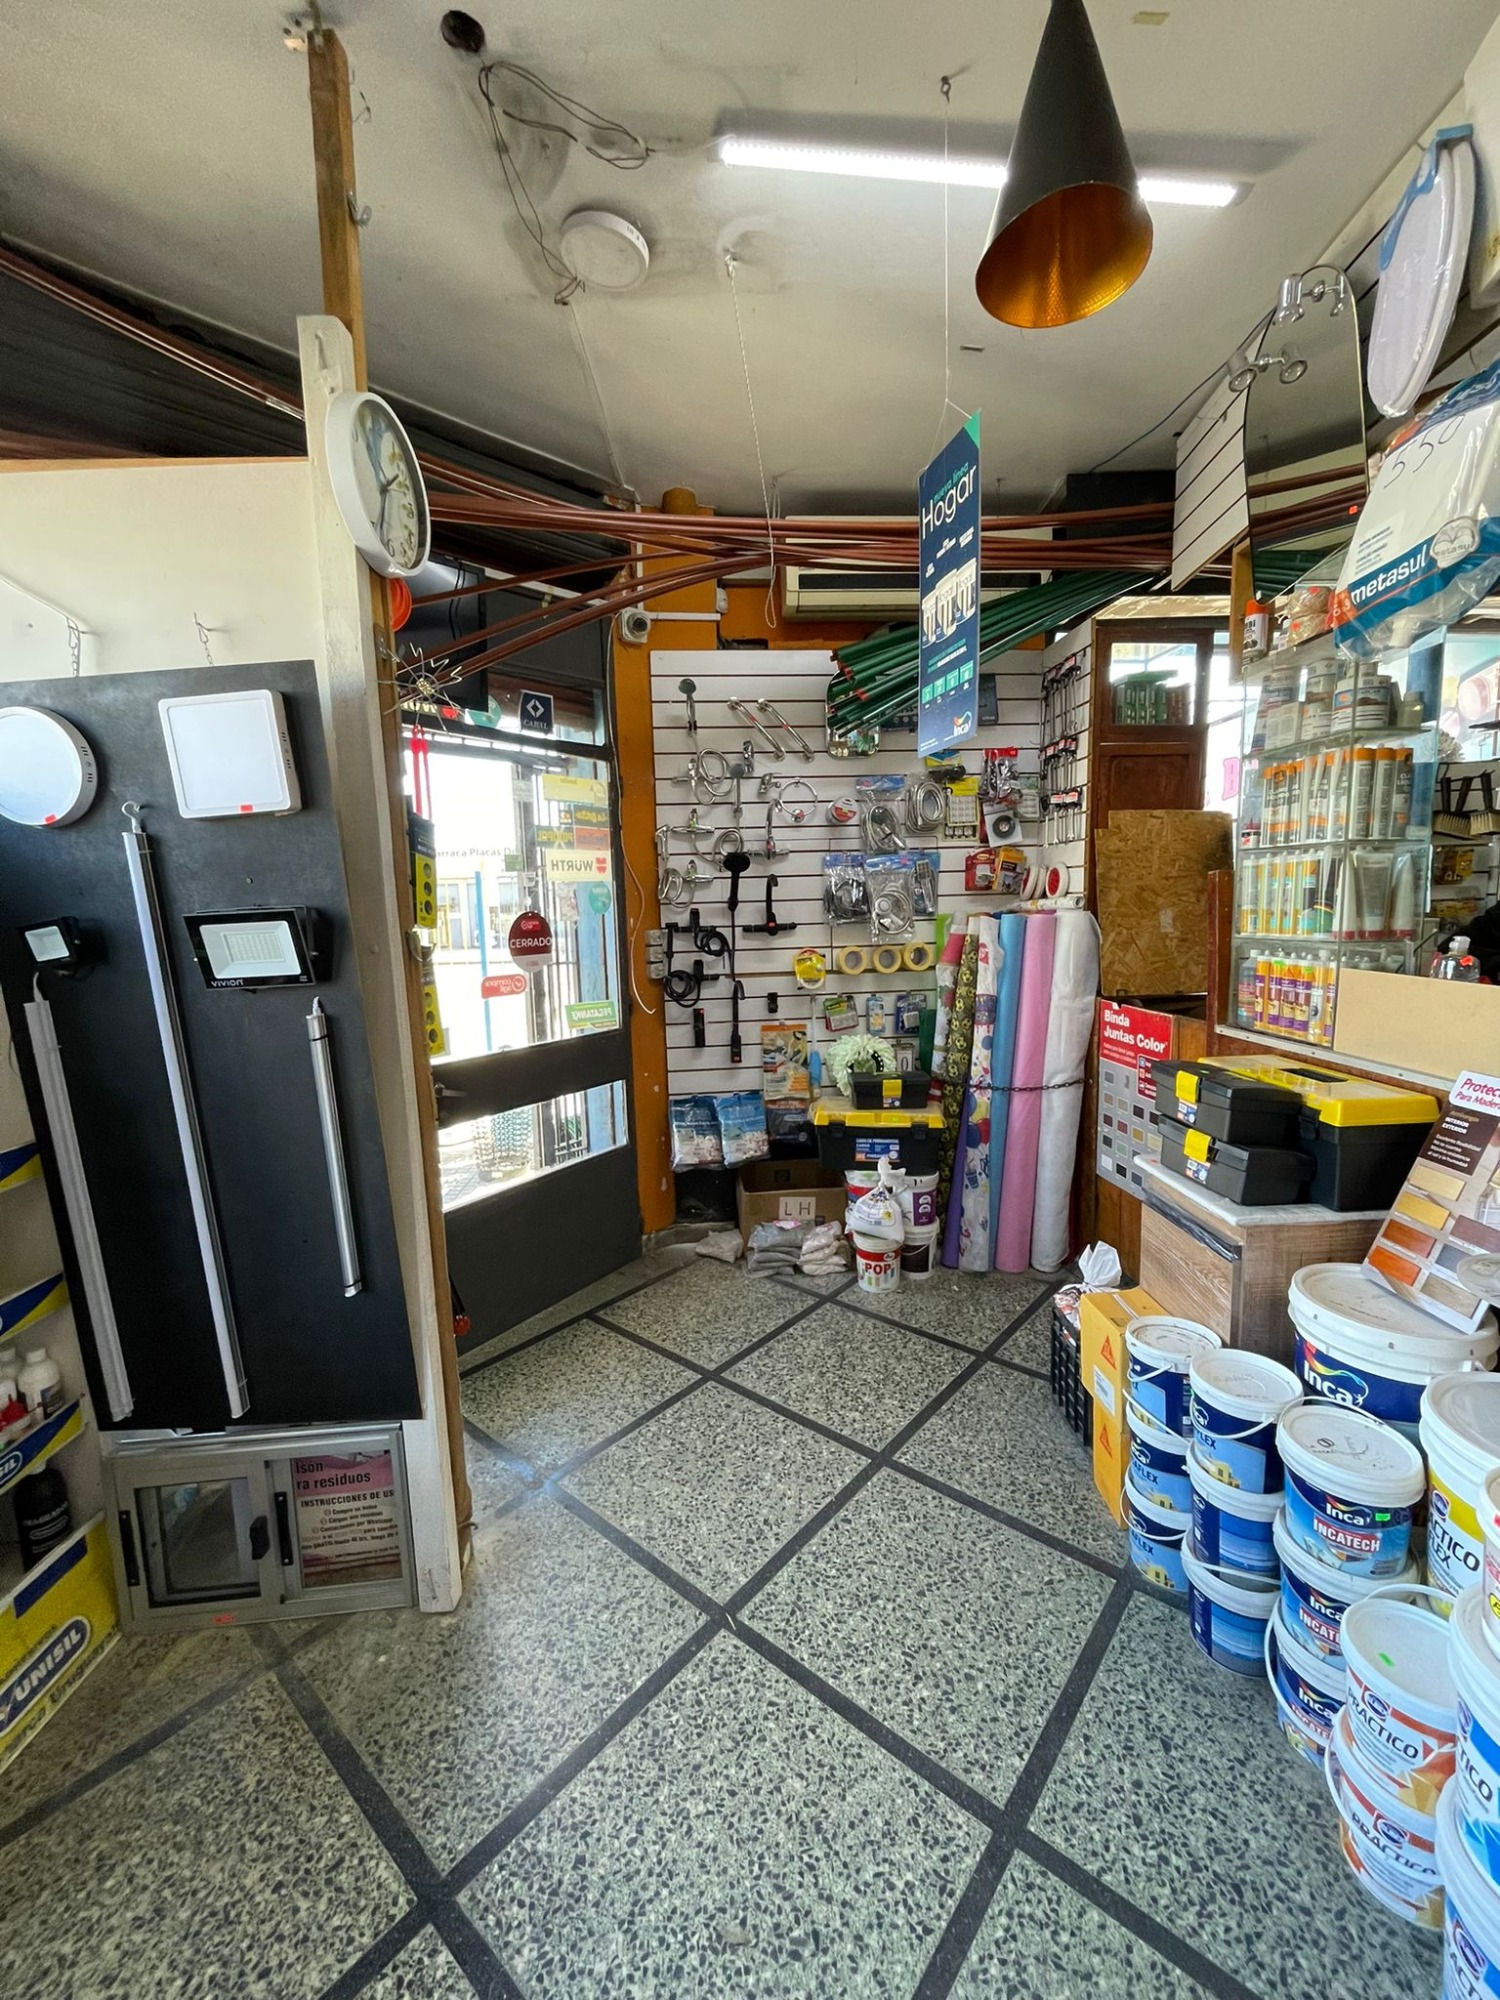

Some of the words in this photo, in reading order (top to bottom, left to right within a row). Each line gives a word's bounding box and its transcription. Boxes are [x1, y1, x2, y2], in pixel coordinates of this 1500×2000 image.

[922, 465, 977, 540] Hogar
[1351, 543, 1427, 606] metasul
[510, 936, 553, 949] CERRADO
[1104, 1009, 1130, 1027] Binda
[1104, 1025, 1135, 1046] Juntas
[1136, 1033, 1166, 1053] Color
[1455, 1091, 1472, 1103] Para
[1445, 1116, 1470, 1128] INTERIOR
[864, 1262, 891, 1275] POP
[1304, 1360, 1354, 1408] Inca
[314, 1472, 371, 1489] residuos
[301, 1493, 367, 1507] INSTRUCCIONES
[369, 1490, 380, 1499] DE
[383, 1489, 395, 1498] US
[1326, 1502, 1365, 1526] Inca
[1313, 1518, 1381, 1553] INCATECH
[15, 1629, 82, 1701] UNISIL
[1348, 1686, 1419, 1759] PRACTICO
